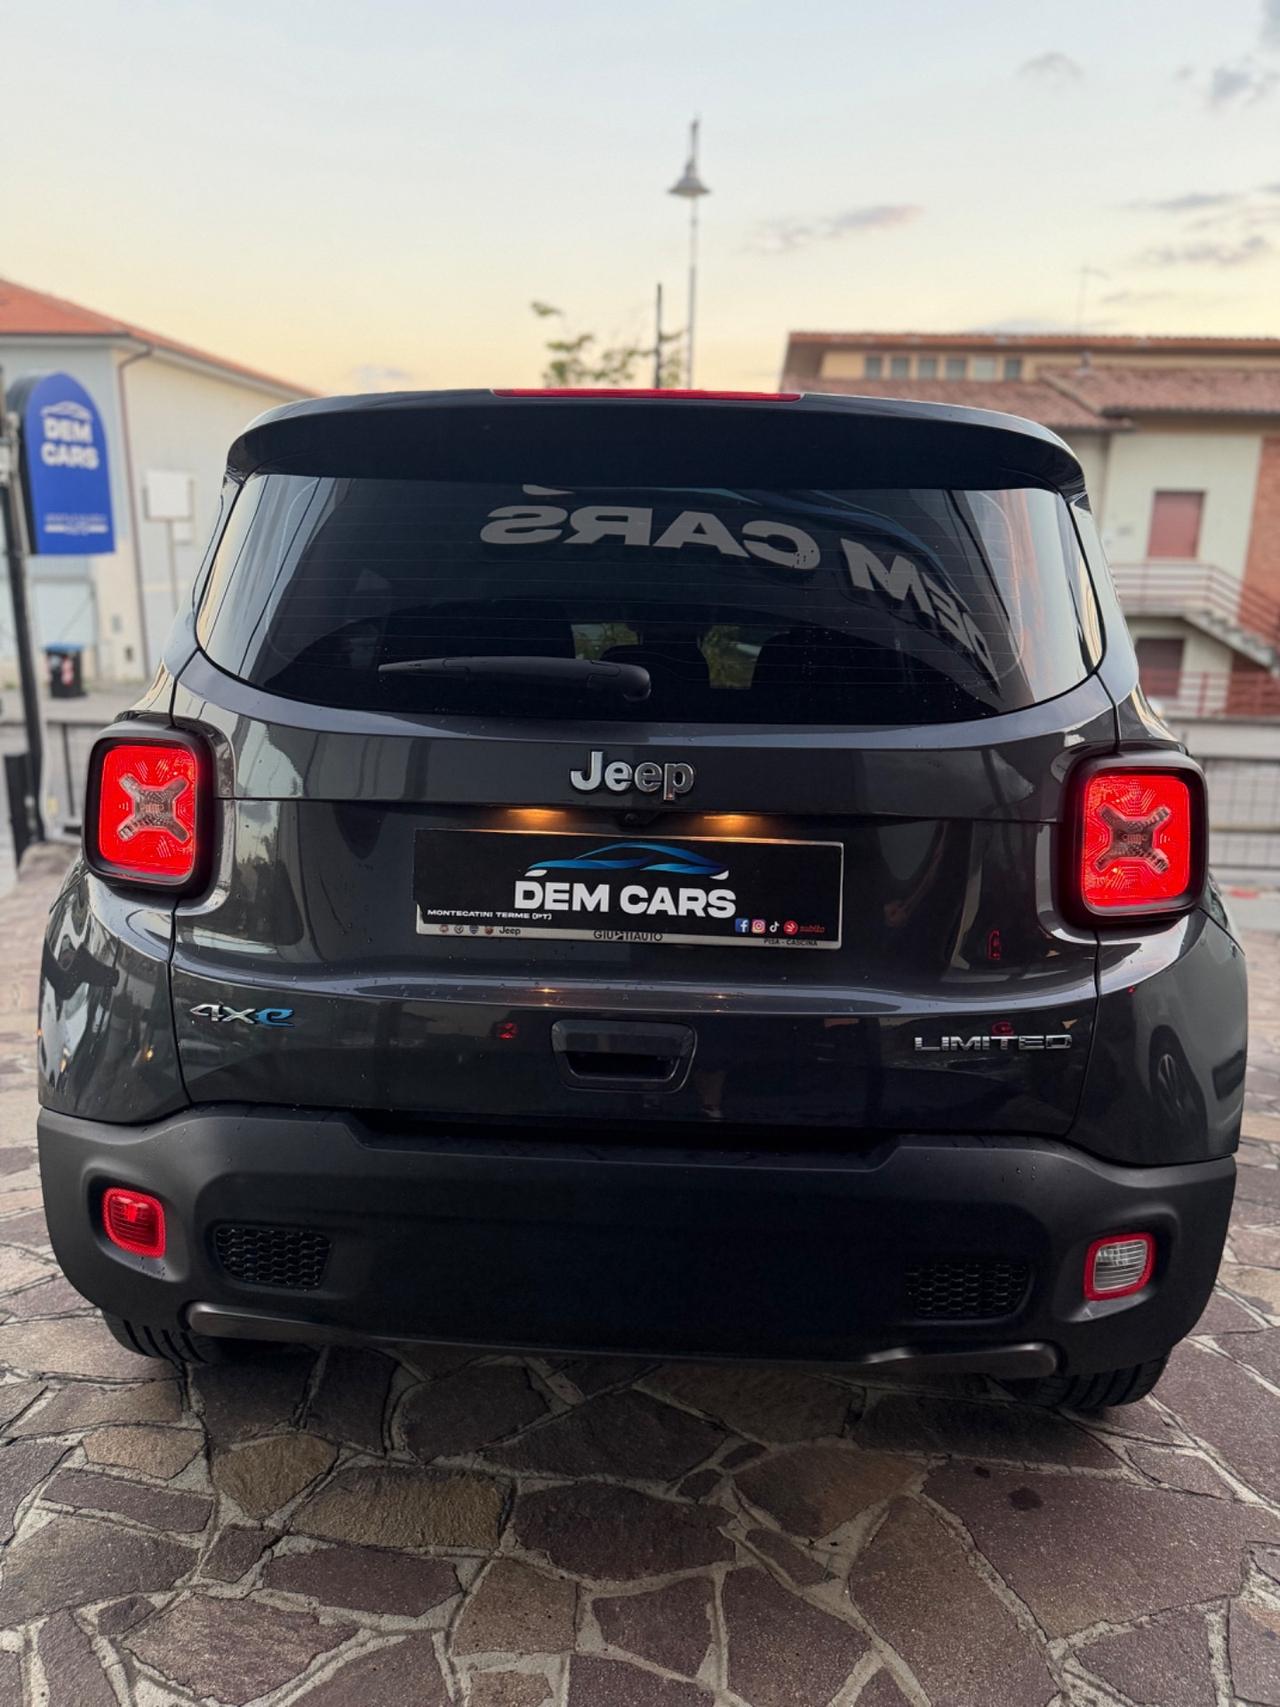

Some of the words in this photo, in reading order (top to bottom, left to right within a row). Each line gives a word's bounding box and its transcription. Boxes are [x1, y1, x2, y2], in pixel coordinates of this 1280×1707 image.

[44, 416, 94, 443] DEM
[41, 442, 99, 469] CARS
[570, 750, 695, 801] Jeep
[514, 880, 610, 912] DEM
[619, 884, 737, 918] CARS
[427, 909, 494, 918] MONTECATINI
[496, 911, 530, 919] TERME
[532, 912, 552, 921] (PT)
[499, 926, 521, 936] Jeep
[914, 1034, 1073, 1050] LIMITED
